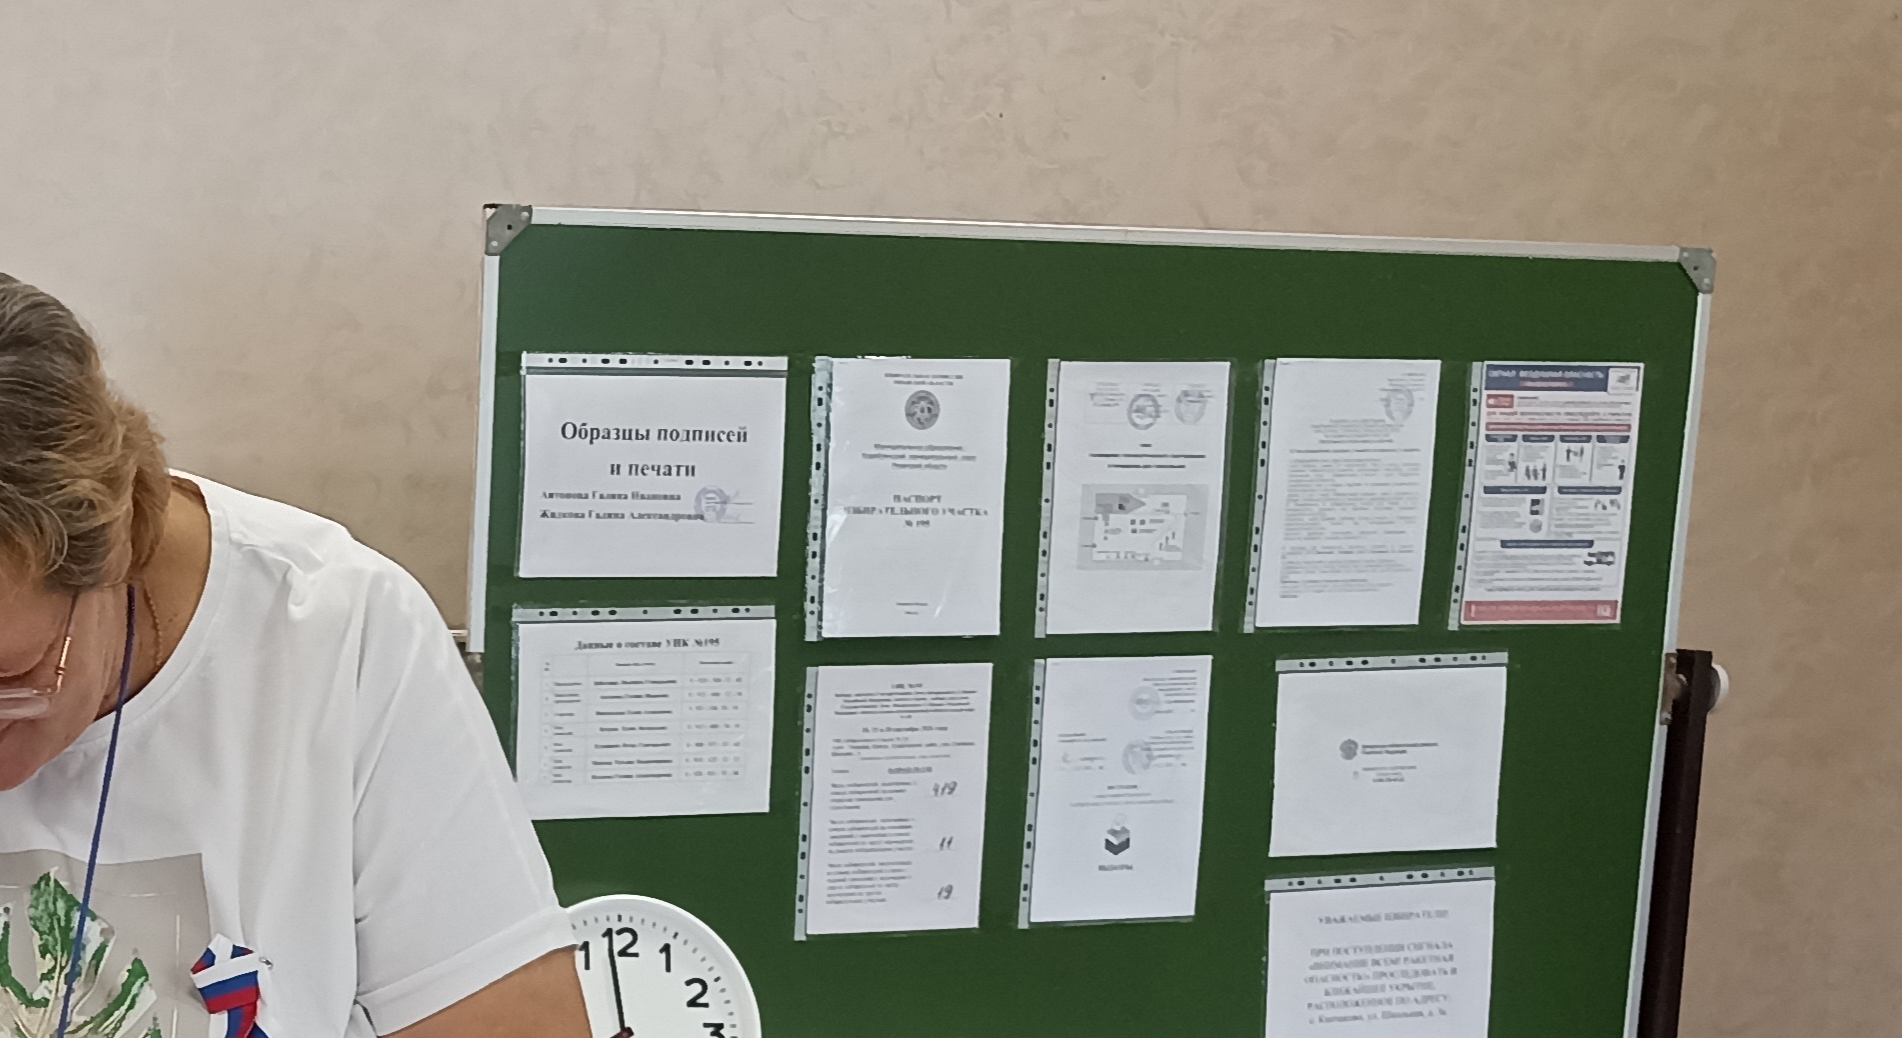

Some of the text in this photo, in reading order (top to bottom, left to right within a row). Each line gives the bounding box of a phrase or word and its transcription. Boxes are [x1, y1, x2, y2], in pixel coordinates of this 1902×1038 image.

[561, 421, 748, 445] Образцы подписей
[610, 463, 696, 477] и печати
[602, 927, 640, 957] 12
[658, 942, 672, 973] 1
[684, 977, 710, 1008] 2
